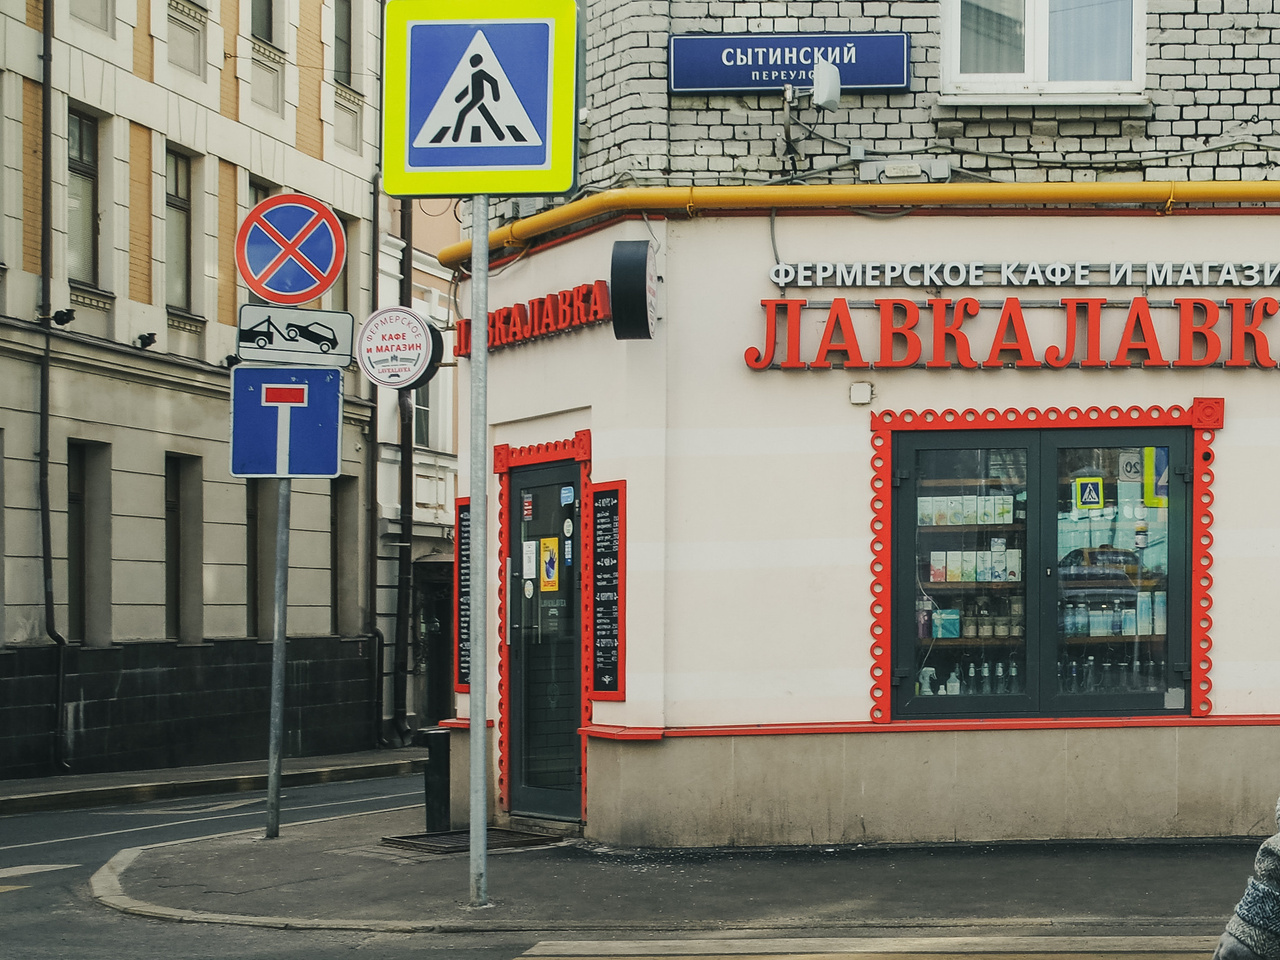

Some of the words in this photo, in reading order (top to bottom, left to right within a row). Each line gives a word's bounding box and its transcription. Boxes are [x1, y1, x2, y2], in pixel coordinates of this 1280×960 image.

[721, 43, 857, 66] СЫТИНСКИЙ
[751, 70, 815, 81] ПЕРЕУЛО
[769, 262, 984, 288] ФЕРМЕРСКОЕ
[1000, 262, 1091, 286] КАФЕ
[1108, 262, 1132, 286] И
[366, 314, 423, 342] ФЕРМЕРСКОЕ
[381, 332, 407, 342] КАФЕ
[376, 343, 422, 353] МАГАЗИН
